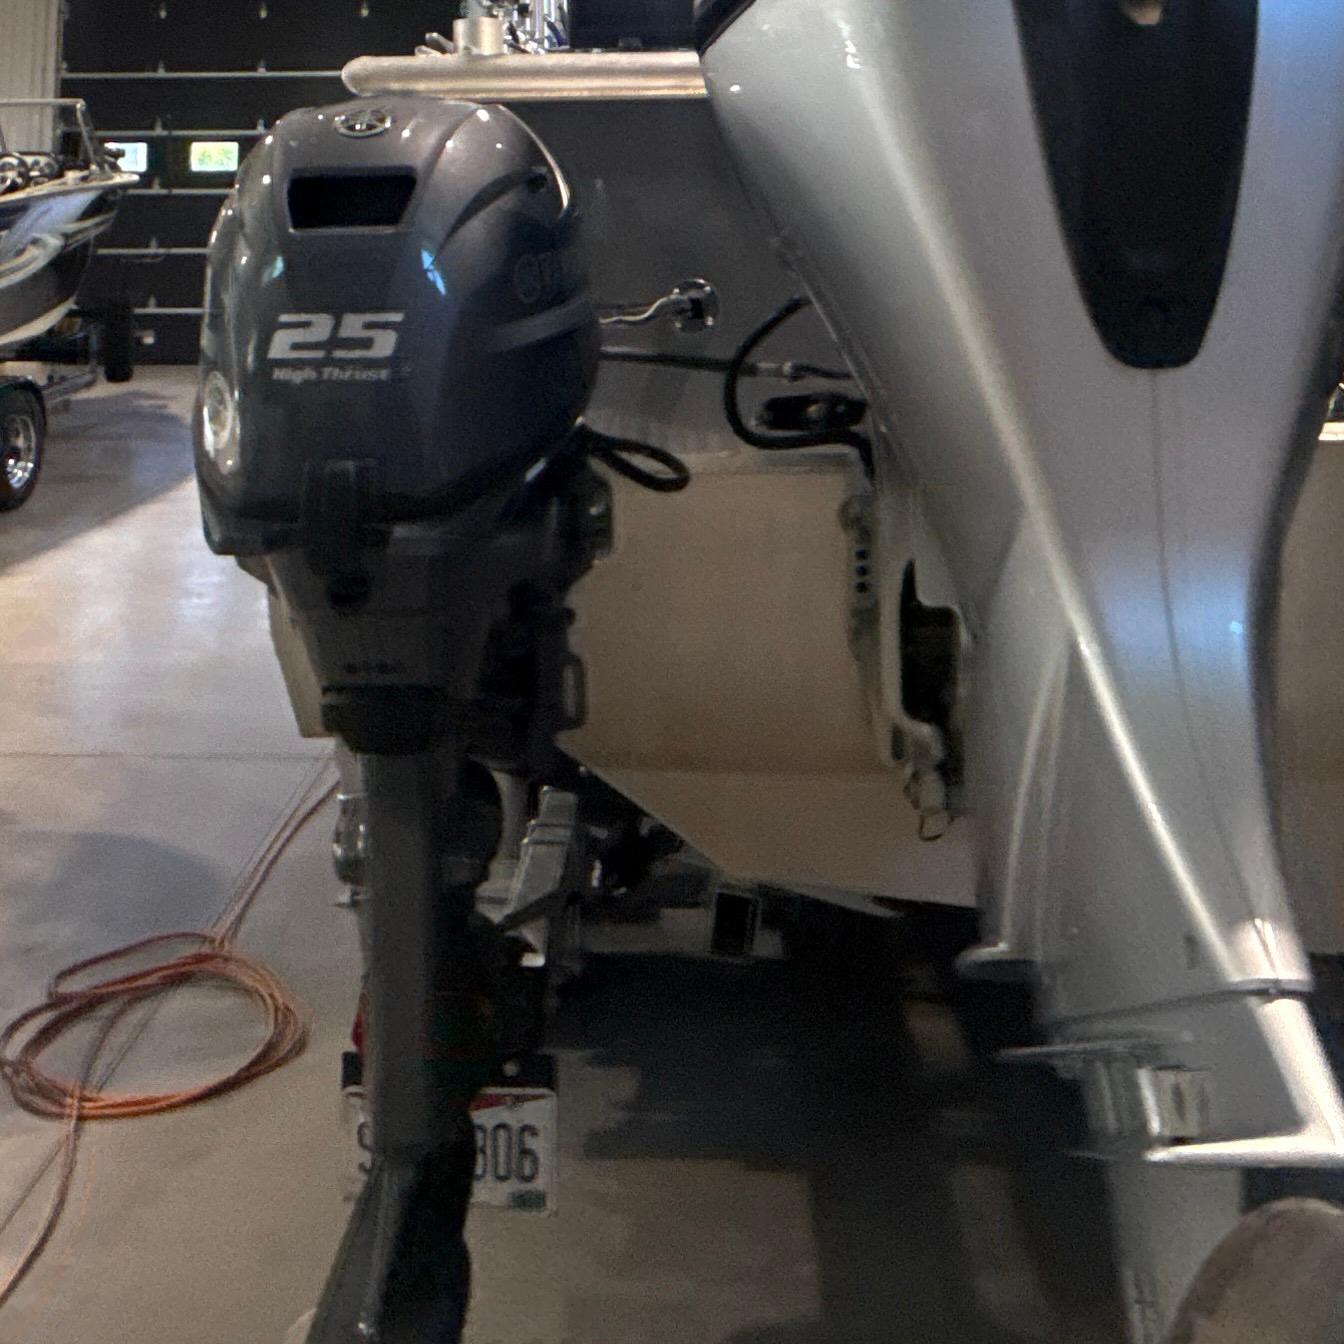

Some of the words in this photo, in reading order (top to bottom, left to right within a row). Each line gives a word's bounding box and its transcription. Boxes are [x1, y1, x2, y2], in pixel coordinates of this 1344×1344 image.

[267, 312, 405, 359] 25
[272, 367, 317, 384] High
[320, 367, 390, 382] Thrust
